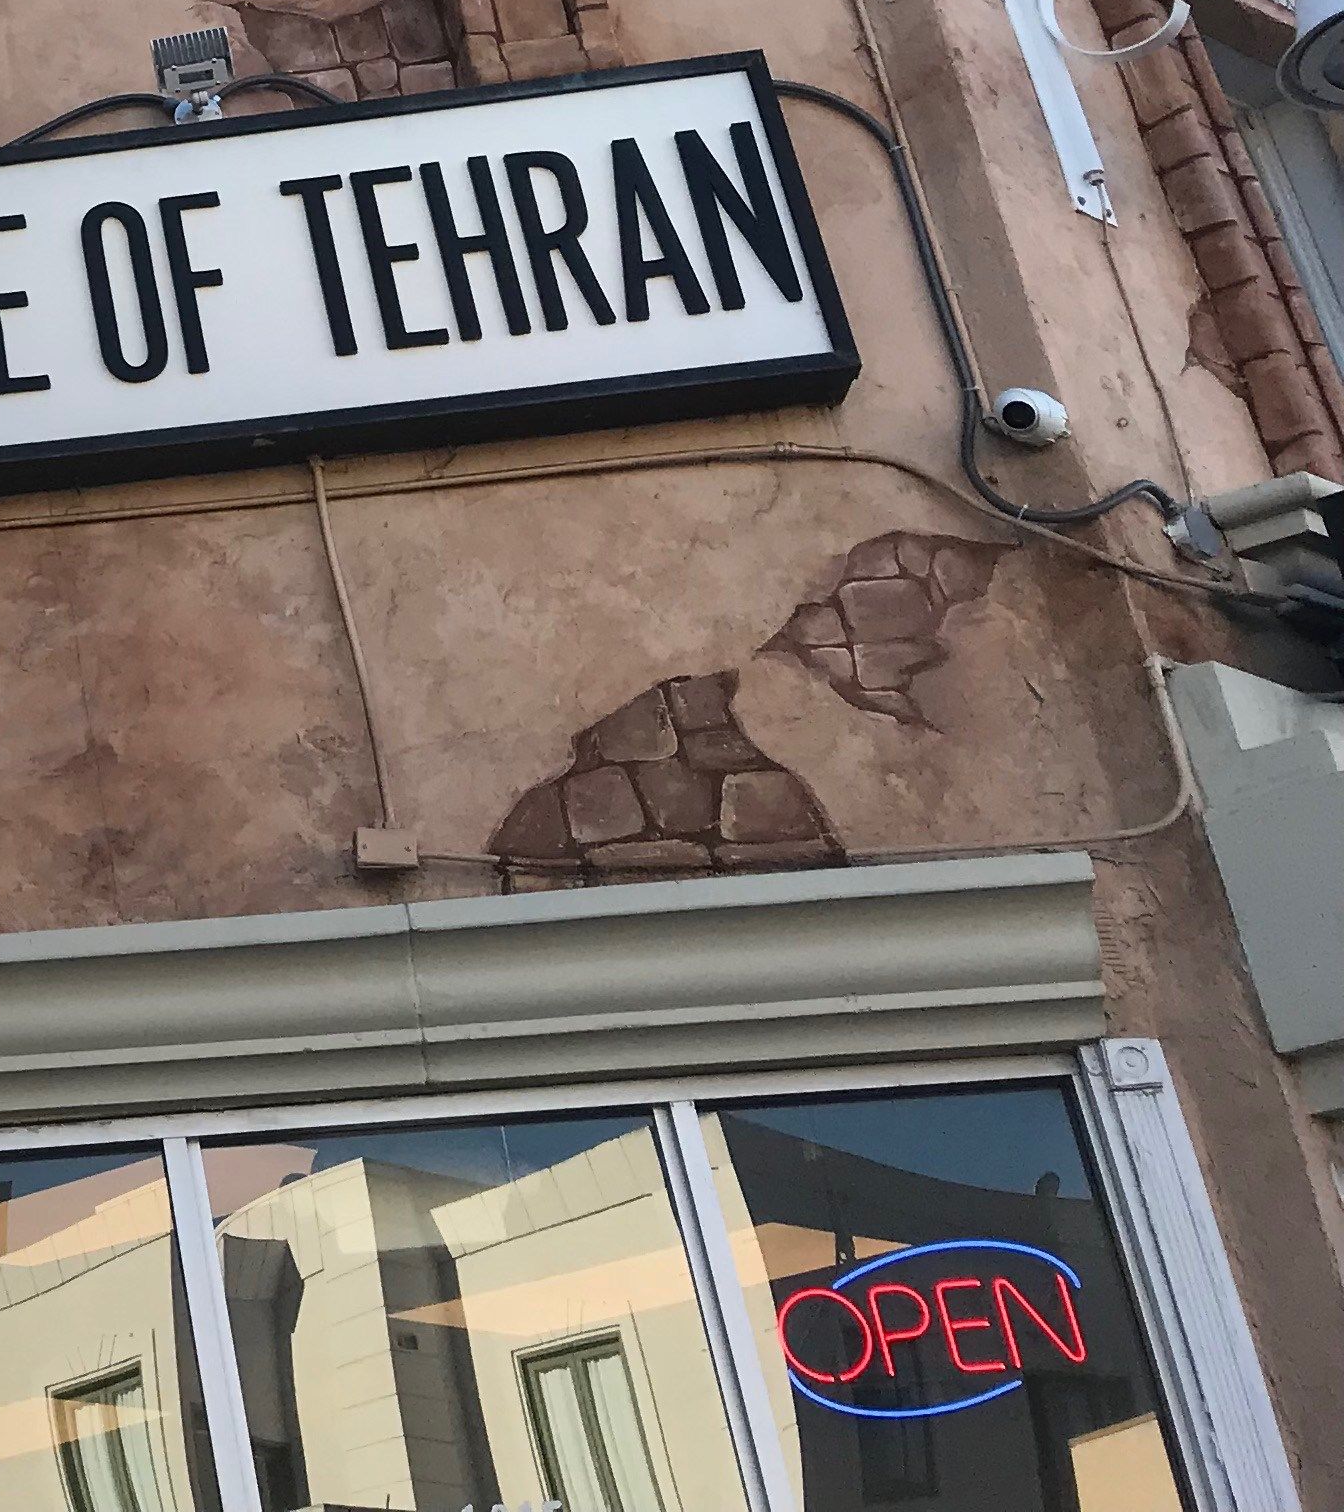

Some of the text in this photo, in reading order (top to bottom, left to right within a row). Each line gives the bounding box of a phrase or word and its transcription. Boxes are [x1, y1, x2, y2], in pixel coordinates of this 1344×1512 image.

[80, 191, 224, 384] OF
[279, 120, 803, 356] TEHRAN
[776, 1273, 1088, 1384] OPEN
